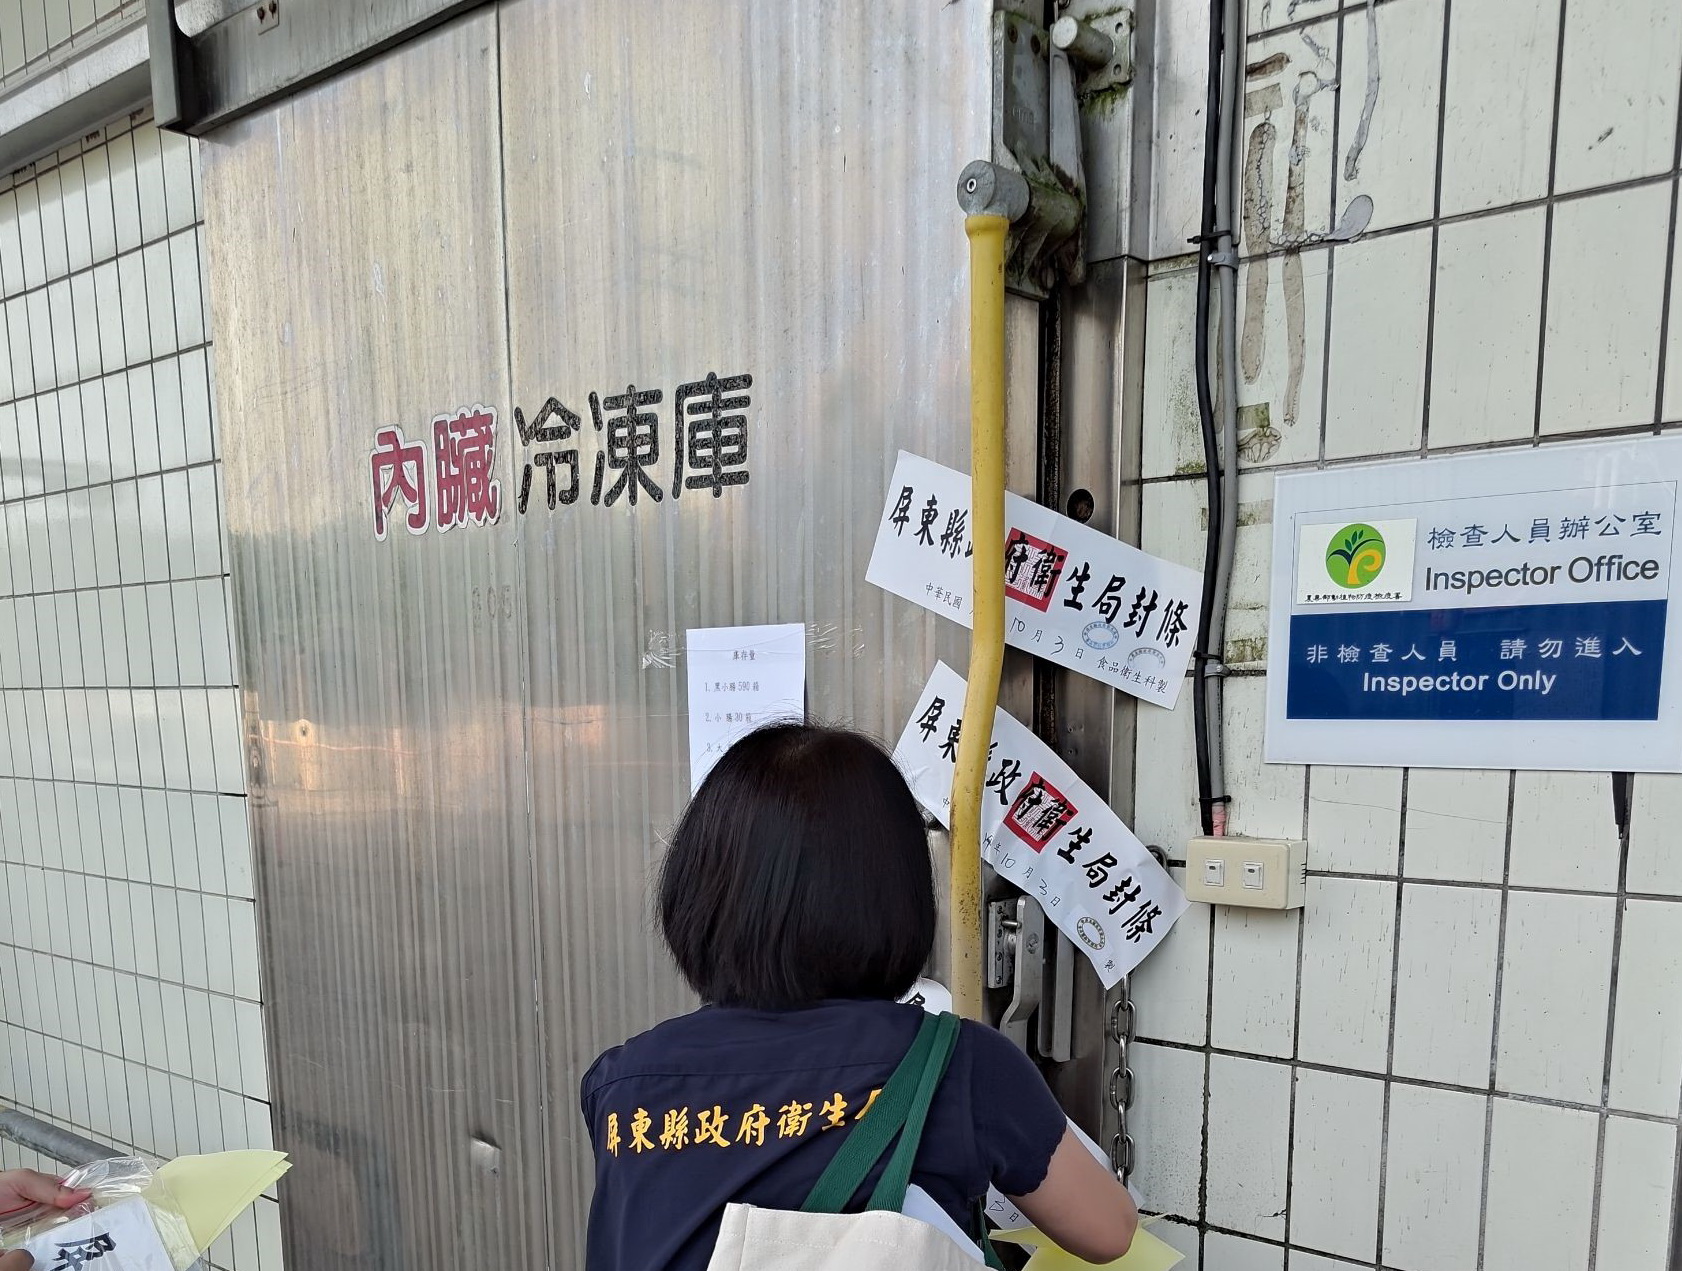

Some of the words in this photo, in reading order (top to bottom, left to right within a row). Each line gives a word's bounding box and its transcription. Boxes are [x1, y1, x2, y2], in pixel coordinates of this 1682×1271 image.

[370, 372, 753, 541] 內臟冷凍庫
[888, 485, 1189, 649] 屏東縣府衛生局封條
[1427, 510, 1662, 551] 檢查人員辦公室
[1425, 564, 1562, 595] Inspector
[1568, 554, 1660, 586] Office
[925, 582, 963, 610] 中華民國
[1097, 656, 1169, 694] 食品衛生科製
[1306, 640, 1458, 664] 非檢查人員
[1500, 637, 1642, 660] 請勿進入
[1363, 673, 1488, 696] Inspector
[1497, 670, 1556, 695] Only
[916, 695, 1162, 943] 屏東政府衛生局封條
